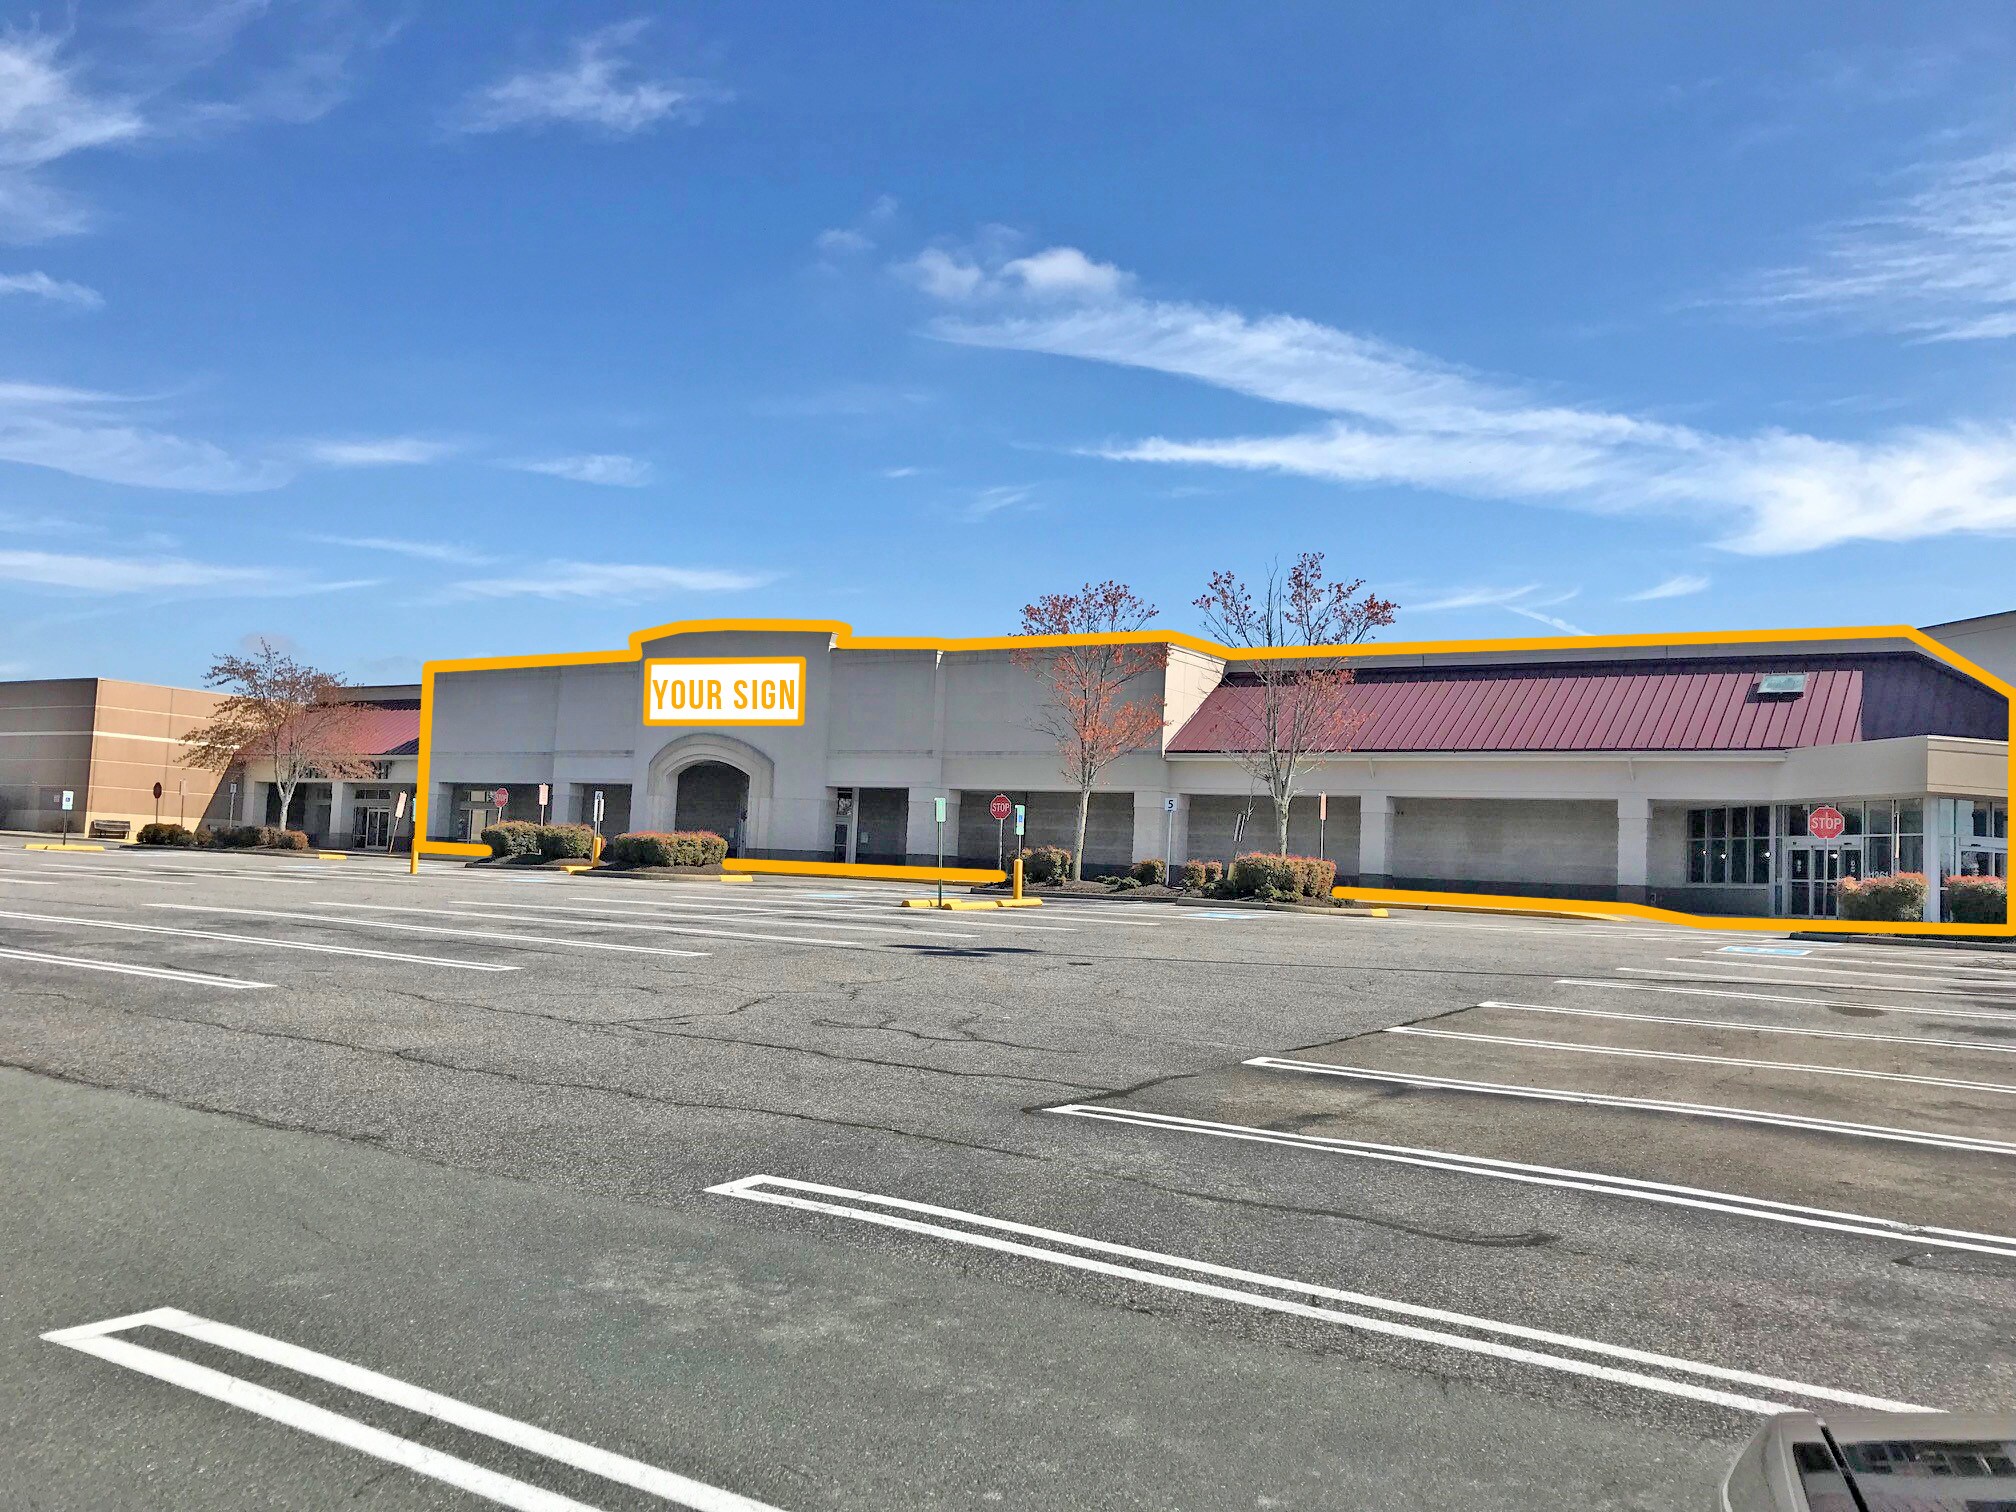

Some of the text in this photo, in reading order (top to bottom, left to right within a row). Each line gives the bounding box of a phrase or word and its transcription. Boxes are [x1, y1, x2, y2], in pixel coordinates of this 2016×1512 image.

[992, 803, 1010, 812] STOP
[1168, 799, 1174, 809] 5
[1811, 817, 1842, 830] STOP
